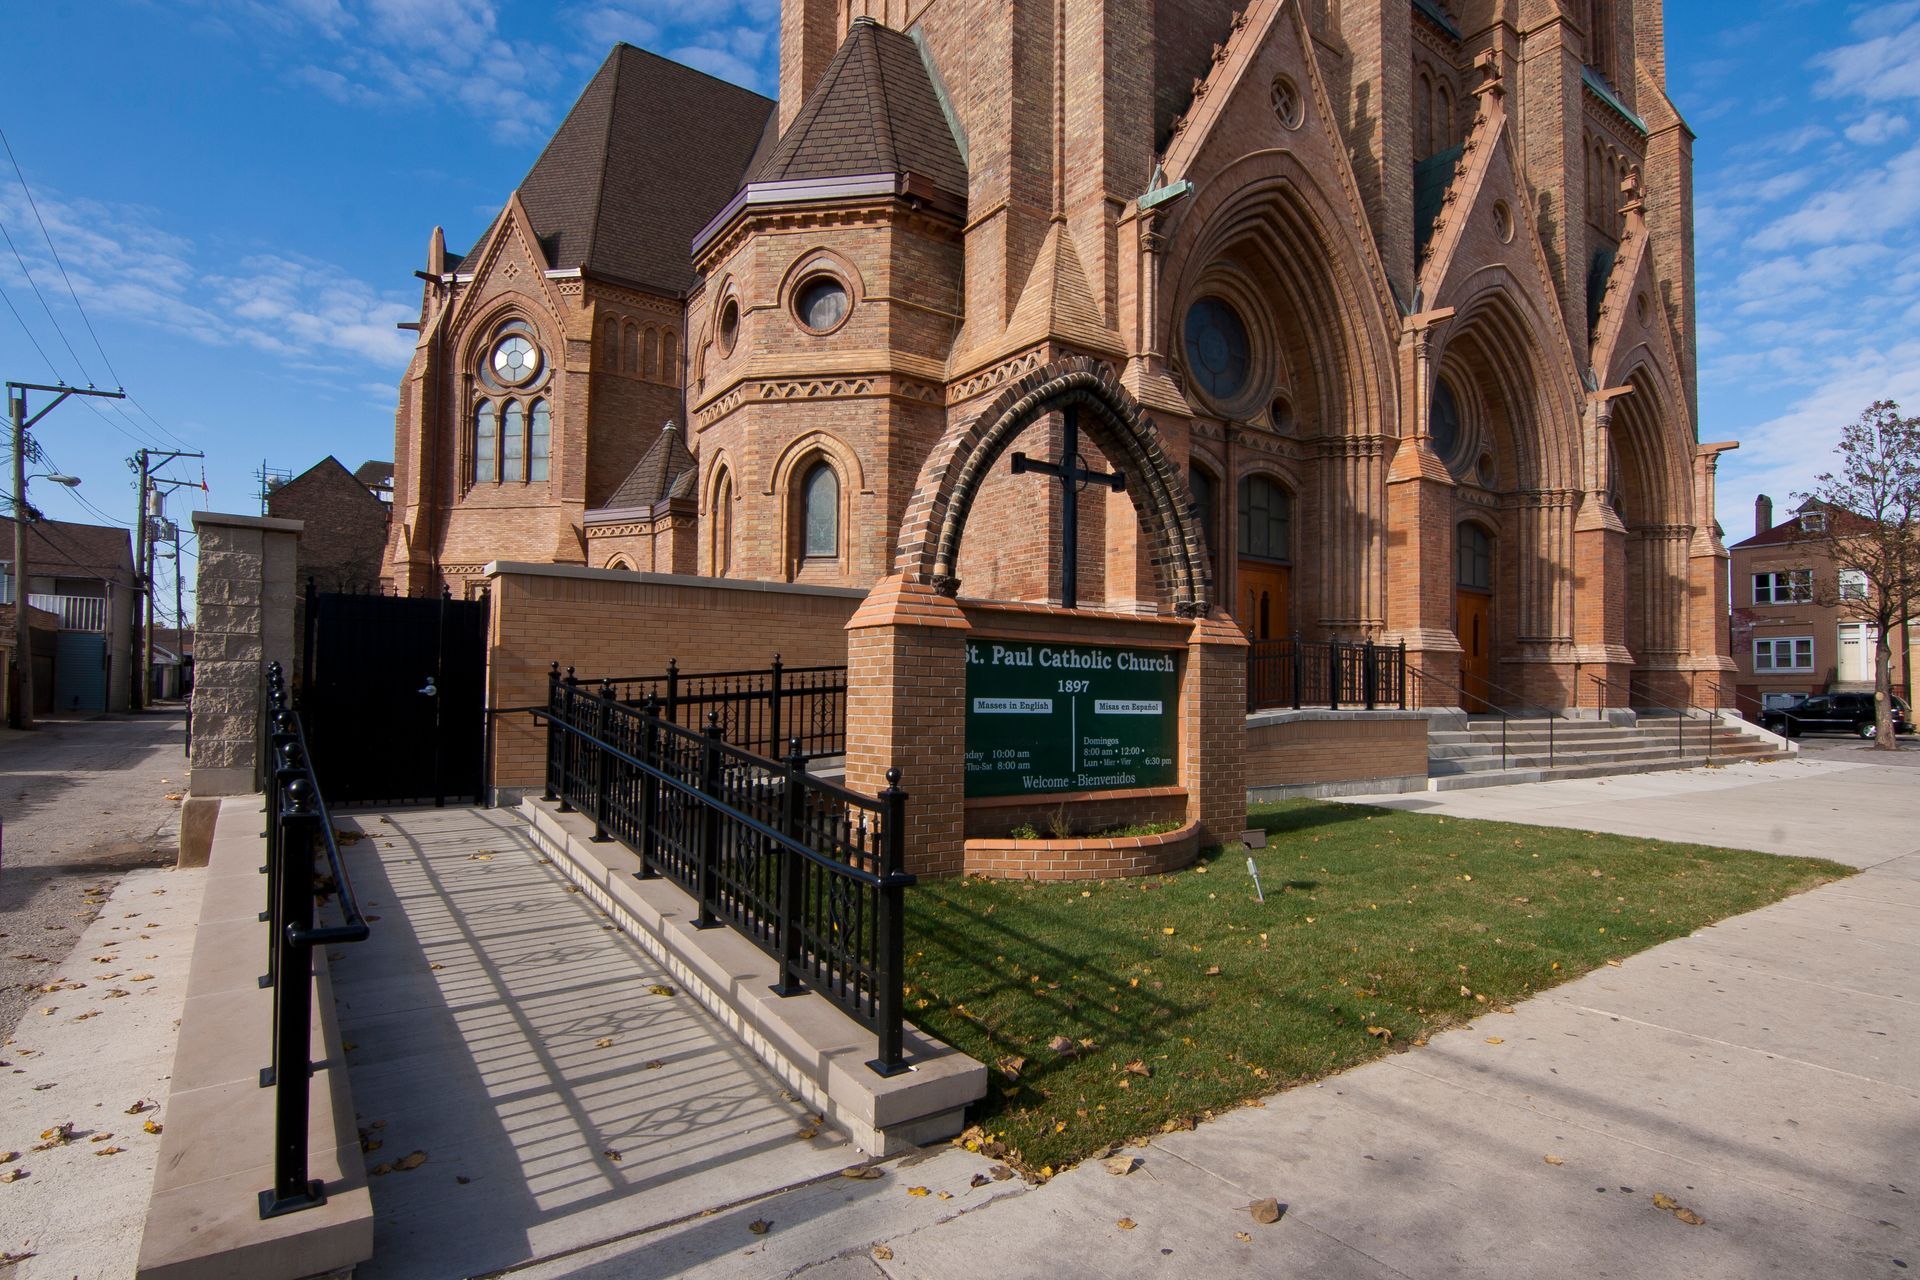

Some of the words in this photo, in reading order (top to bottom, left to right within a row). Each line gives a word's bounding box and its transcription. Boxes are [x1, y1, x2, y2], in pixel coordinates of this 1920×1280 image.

[992, 645, 1033, 666] Paul
[1039, 647, 1112, 669] Catholic
[1117, 652, 1174, 672] Church
[1058, 680, 1090, 693] 1897
[978, 701, 1007, 710] Masses
[1009, 701, 1018, 710] in
[1020, 701, 1049, 712] English
[1099, 702, 1120, 711] Misas
[1131, 703, 1159, 713] Español
[1083, 736, 1119, 746] Domingos
[964, 750, 984, 761] nday
[992, 749, 1015, 759] 10:00
[1017, 750, 1030, 758] am
[1083, 747, 1100, 756] 8:00
[1101, 748, 1113, 756] am
[1120, 746, 1140, 755] 12:00
[997, 760, 1016, 770] 8:00
[1083, 758, 1098, 767] Lun
[1145, 757, 1160, 766] 6:30
[1161, 758, 1172, 767] pm
[1022, 775, 1069, 789] Welcome
[1077, 771, 1136, 787] Bienvenidos
